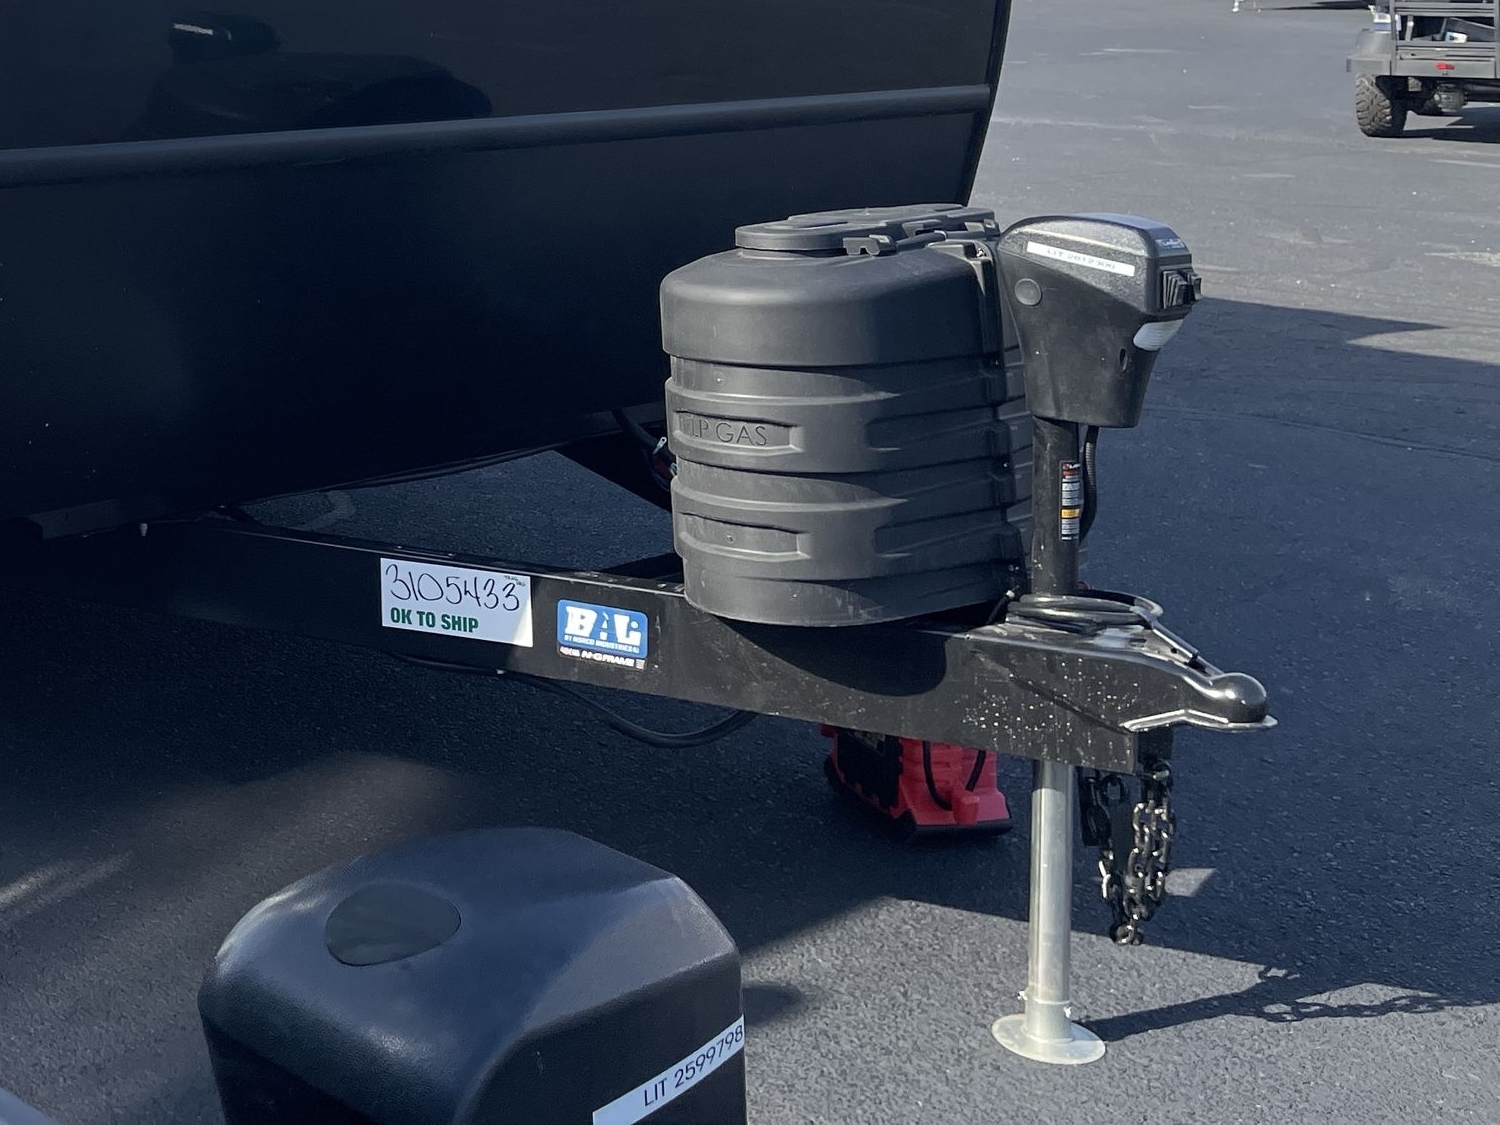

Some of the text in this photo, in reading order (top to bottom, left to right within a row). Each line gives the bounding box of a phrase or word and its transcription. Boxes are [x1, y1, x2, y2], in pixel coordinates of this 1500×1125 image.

[715, 422, 767, 447] GAS
[386, 564, 520, 611] 3105433
[390, 607, 479, 633] OK TO SHIP
[644, 1025, 743, 1106] LIT 2599798
